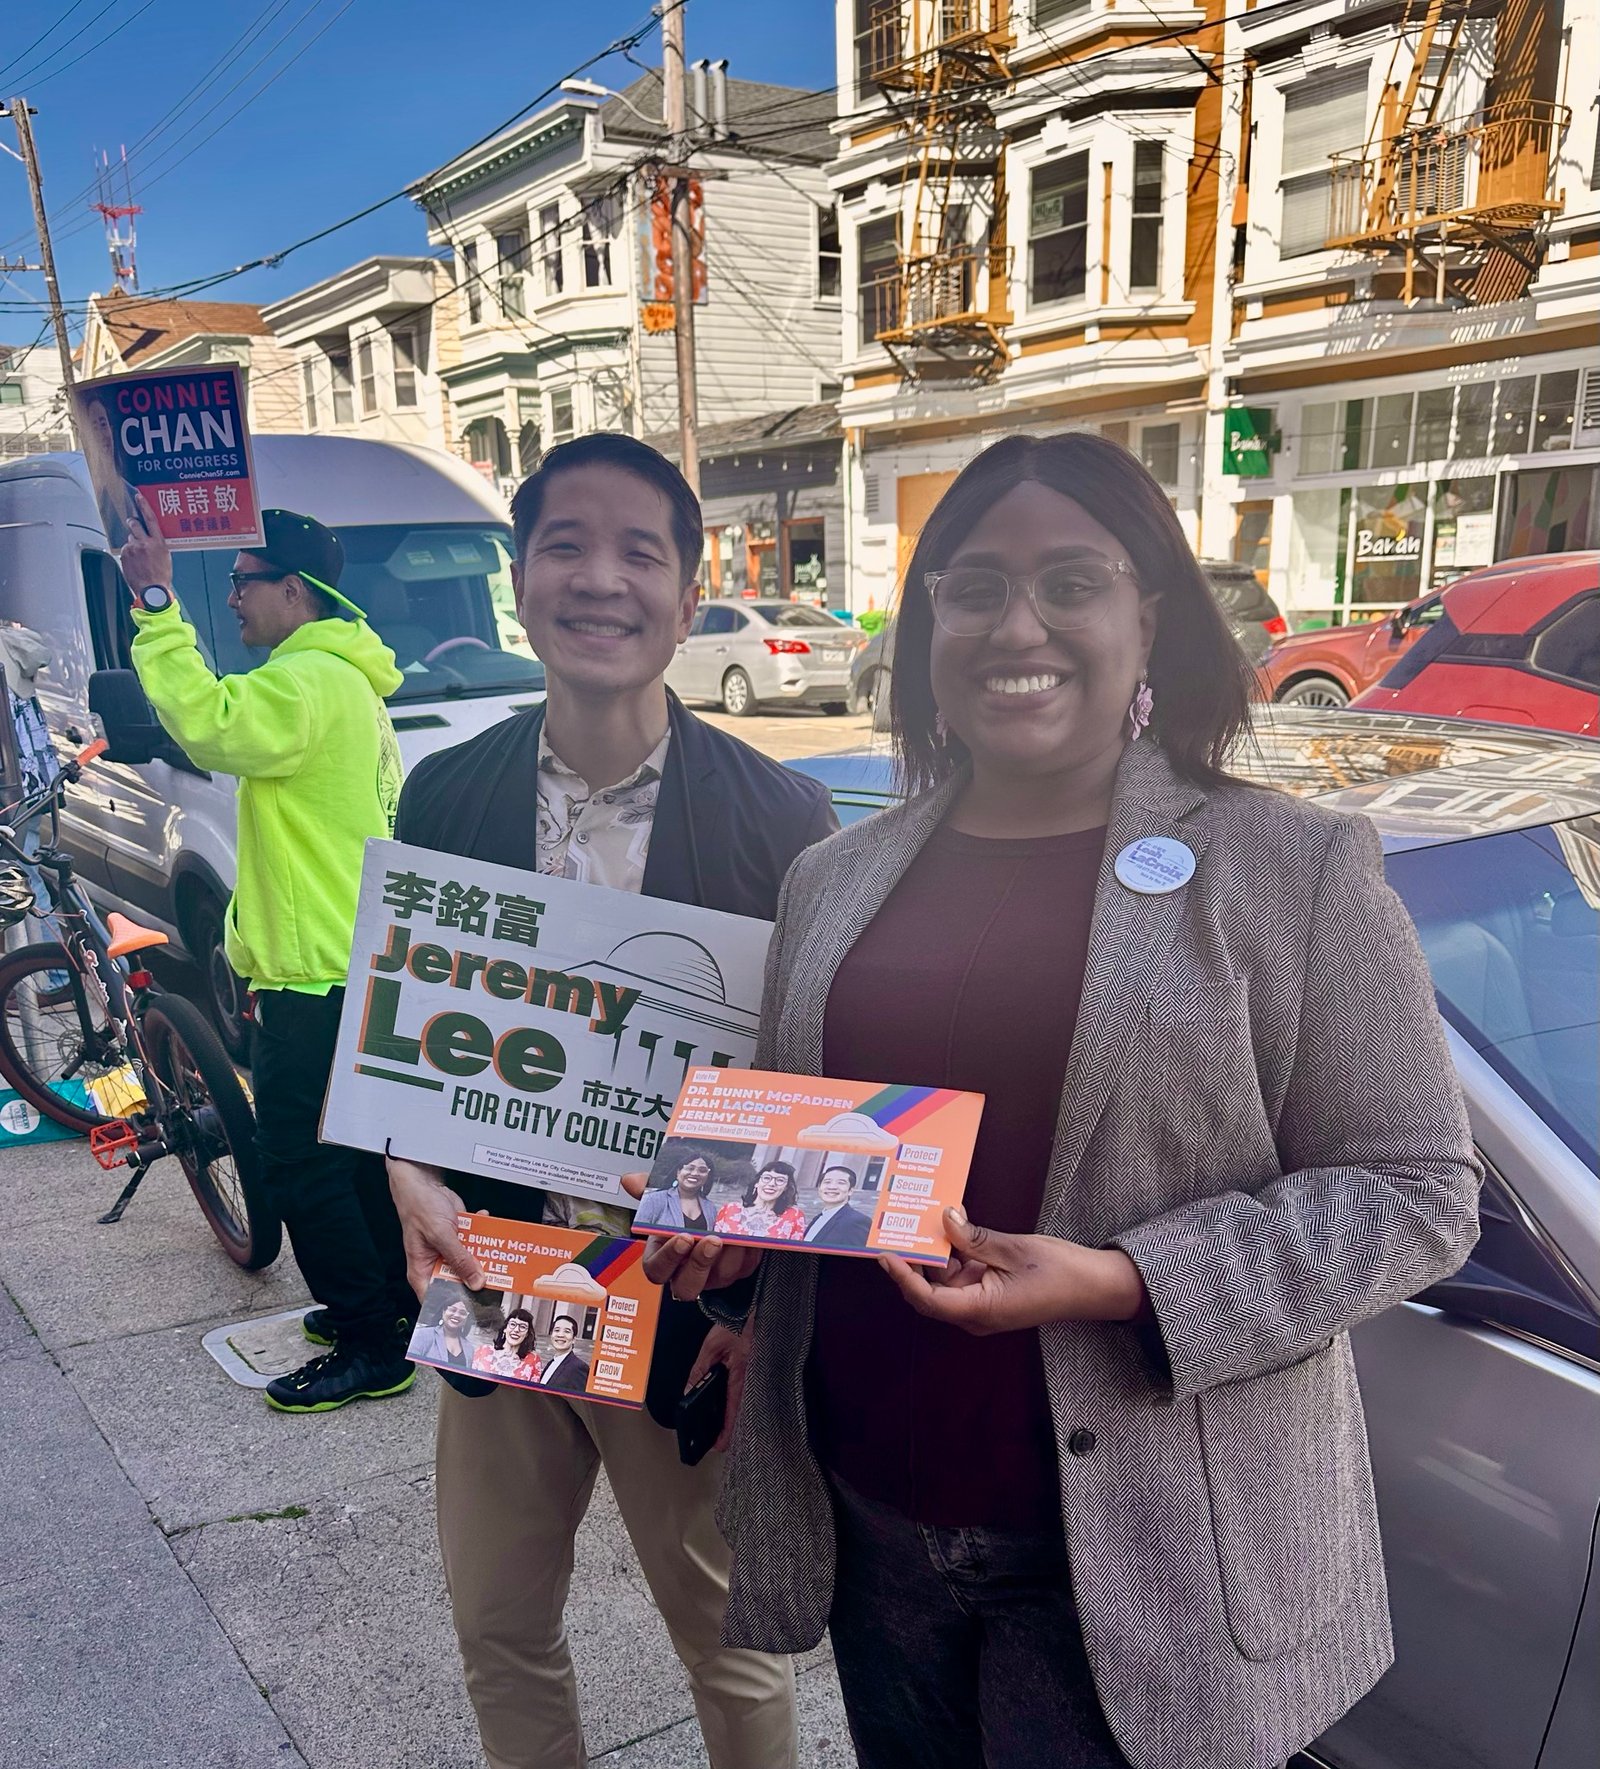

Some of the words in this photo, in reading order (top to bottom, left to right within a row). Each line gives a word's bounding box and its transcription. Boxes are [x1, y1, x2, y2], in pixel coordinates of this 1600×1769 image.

[117, 380, 231, 414] CONNIE
[120, 409, 236, 456] CHAN
[138, 459, 161, 473] FOR
[165, 454, 238, 471] CONGRESS
[179, 470, 240, 480] ConnieChanSF.com
[158, 484, 239, 517] 陳詩敏
[1128, 850, 1184, 881] LaCroix
[382, 870, 546, 948] 李銘富
[370, 924, 643, 1036] Jeremy
[358, 975, 567, 1093] Lee
[687, 1086, 709, 1096] DR.
[712, 1087, 764, 1100] BUNNY
[450, 1085, 500, 1125] FOR
[504, 1098, 562, 1138] CITY
[683, 1098, 721, 1109] LEAH
[679, 1110, 737, 1123] JEREMY
[738, 1113, 765, 1126] LEE
[904, 1147, 938, 1161] Protect
[486, 1150, 497, 1158] Paid
[513, 1156, 531, 1166] Jeremy
[560, 1167, 579, 1176] College
[580, 1171, 594, 1179] Board
[488, 1158, 511, 1167] Financial
[511, 1163, 538, 1173] disclosures
[548, 1170, 569, 1180] available
[896, 1178, 929, 1193] Secure
[886, 1215, 916, 1229] GROW
[457, 1232, 466, 1241] R.
[468, 1234, 505, 1248] BUNNY
[488, 1262, 508, 1274] LEE
[611, 1299, 635, 1312] Protect
[606, 1329, 629, 1342] Secure
[600, 1364, 620, 1376] GROW
